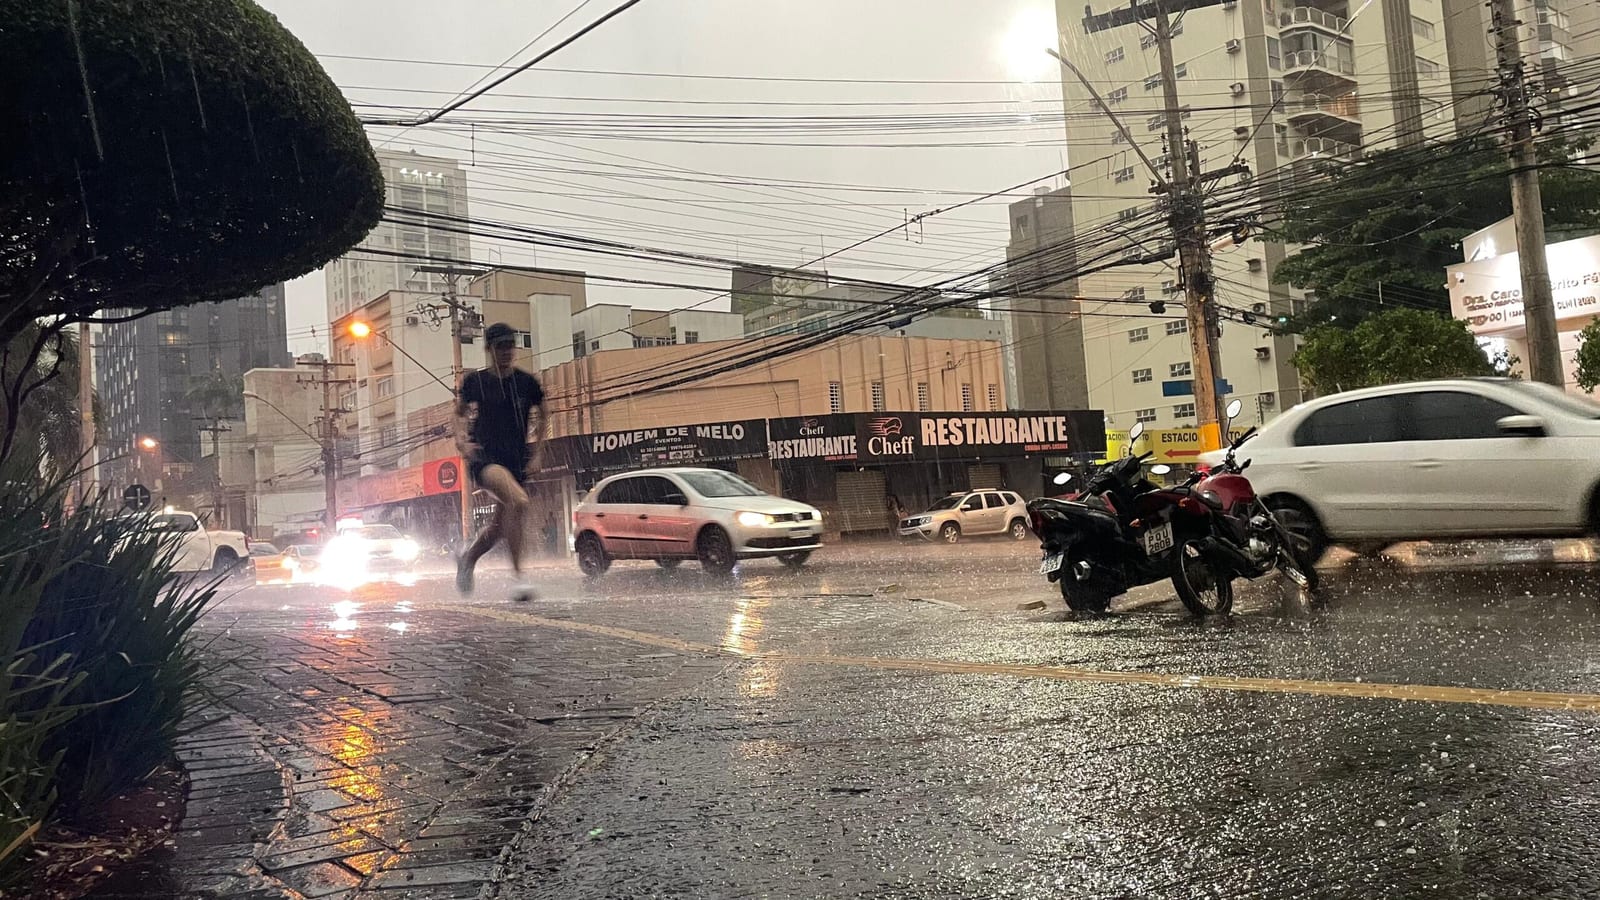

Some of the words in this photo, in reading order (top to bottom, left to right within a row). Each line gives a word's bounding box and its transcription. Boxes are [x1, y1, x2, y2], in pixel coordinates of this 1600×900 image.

[593, 429, 657, 453] HOMEM
[666, 427, 688, 436] DE
[697, 424, 745, 440] MELO
[799, 426, 824, 436] Cheff
[920, 416, 1068, 446] RESTAURANTE
[769, 435, 857, 460] RESTAURANTE
[868, 436, 914, 455] Cheff
